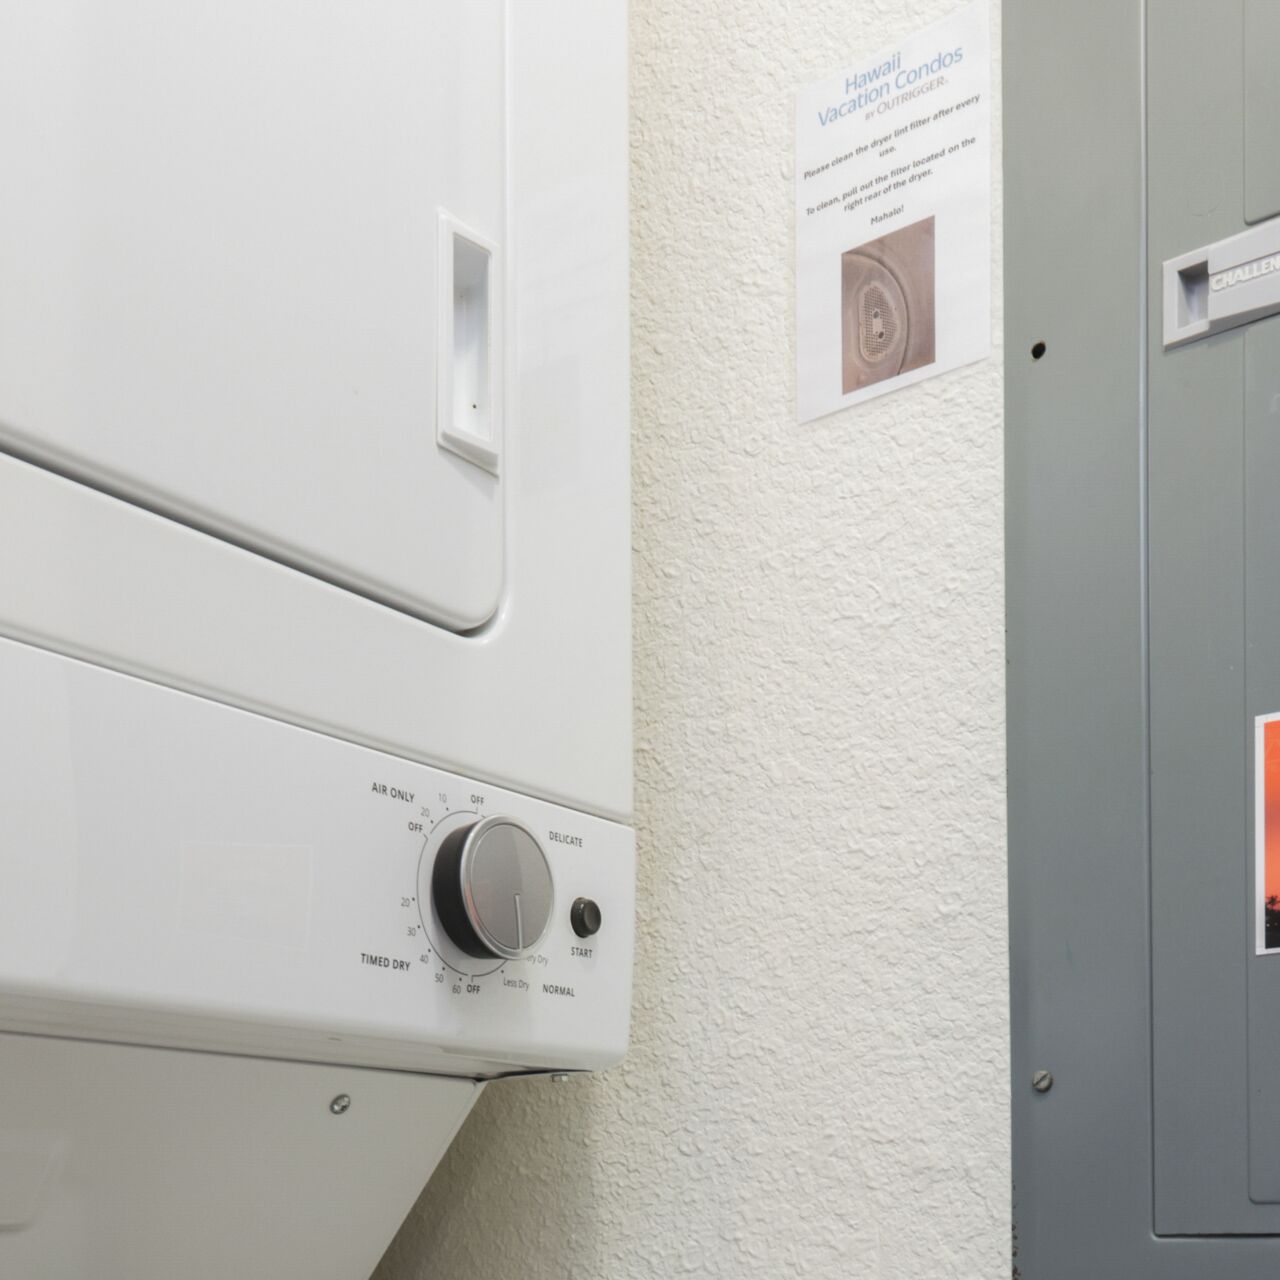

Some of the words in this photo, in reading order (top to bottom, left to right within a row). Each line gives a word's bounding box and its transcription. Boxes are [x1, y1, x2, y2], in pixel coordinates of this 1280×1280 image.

[844, 51, 902, 95] Hawaii
[817, 81, 890, 127] Vacation
[895, 46, 964, 90] Condos
[865, 110, 875, 121] BY
[803, 163, 830, 181] Please
[831, 150, 854, 166] clean
[855, 144, 869, 157] the
[870, 134, 893, 151] dryer
[894, 125, 909, 138] lint
[910, 116, 931, 132] filter
[932, 106, 955, 122] after
[955, 93, 981, 111] every
[879, 146, 896, 158] use.
[806, 207, 816, 216] To
[816, 196, 841, 213] clean,
[842, 186, 858, 202] pull
[859, 180, 874, 192] out
[875, 174, 889, 186] the
[890, 163, 911, 180] filter
[912, 150, 946, 170] located
[948, 144, 960, 154] on
[961, 136, 976, 150] the
[843, 198, 864, 212] right
[864, 189, 882, 202] rear
[883, 184, 892, 194] of
[893, 178, 907, 190] the
[908, 168, 934, 185] dryer.
[870, 204, 905, 226] Mahalo!
[371, 782, 388, 796] AIR
[390, 787, 415, 804] ONLY
[438, 792, 448, 804] 10
[470, 794, 485, 806] OFF
[420, 806, 430, 818] 20
[408, 822, 424, 833] OFF
[549, 830, 584, 848] DELICATE
[400, 896, 410, 908] 20
[407, 926, 416, 936] 30
[420, 954, 429, 964] 40
[570, 946, 593, 959] START
[361, 952, 390, 968] TIMED
[392, 959, 412, 972] DRY
[537, 954, 549, 968] Dry
[434, 972, 444, 984] 50
[503, 976, 518, 989] Less
[518, 979, 530, 992] Dry
[452, 984, 462, 994] 60
[466, 984, 480, 994] OFF
[542, 983, 576, 998] NORMAL
